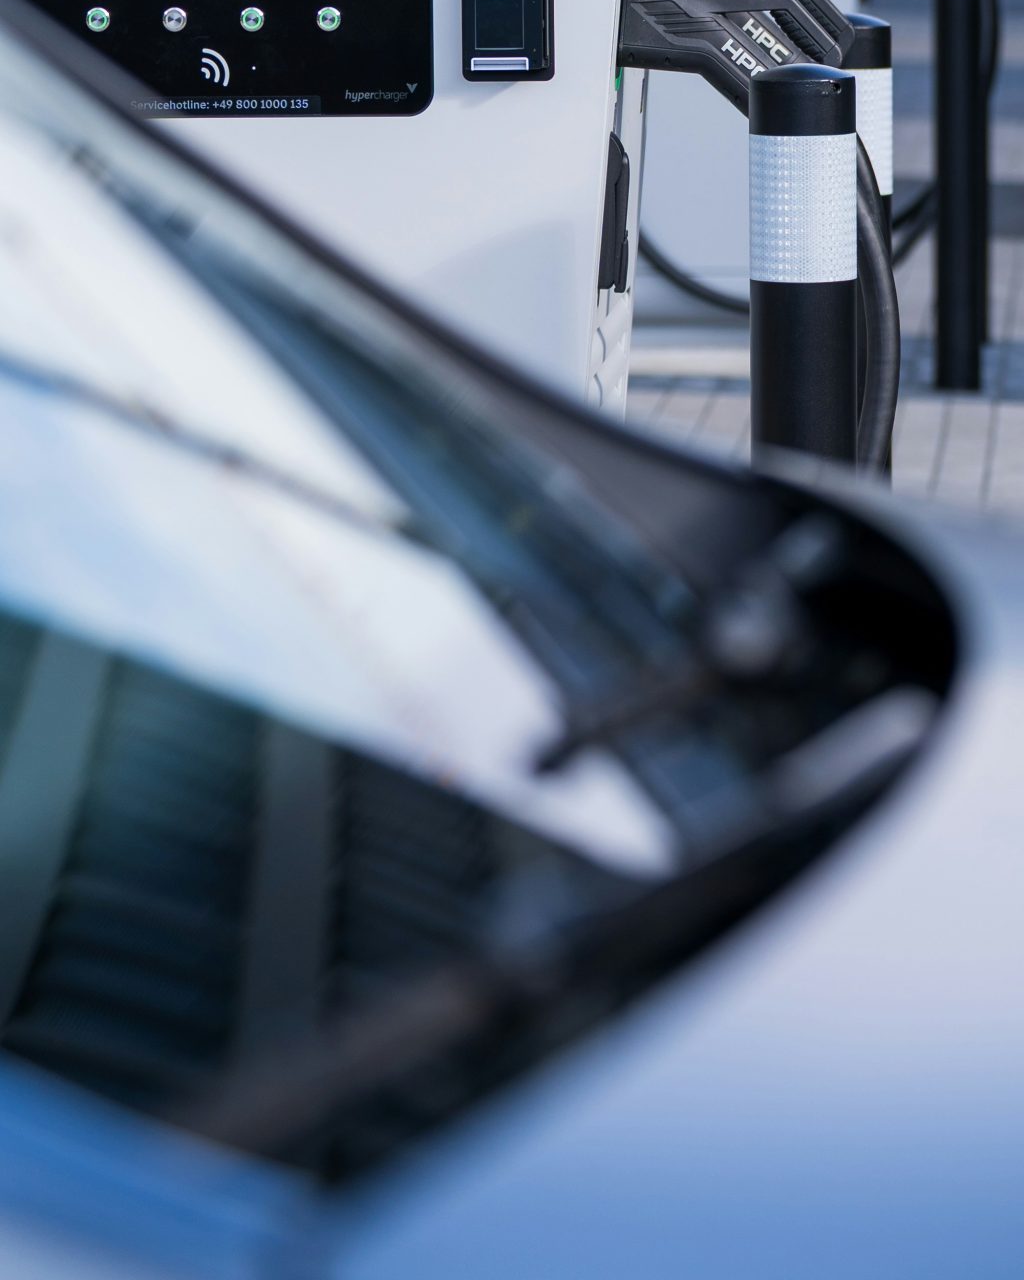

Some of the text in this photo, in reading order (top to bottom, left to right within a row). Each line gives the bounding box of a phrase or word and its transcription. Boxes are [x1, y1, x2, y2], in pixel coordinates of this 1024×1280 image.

[742, 18, 791, 64] HPC
[345, 89, 408, 102] hypercharger
[130, 99, 309, 110] Servicehotline: +49 800 1000 135
